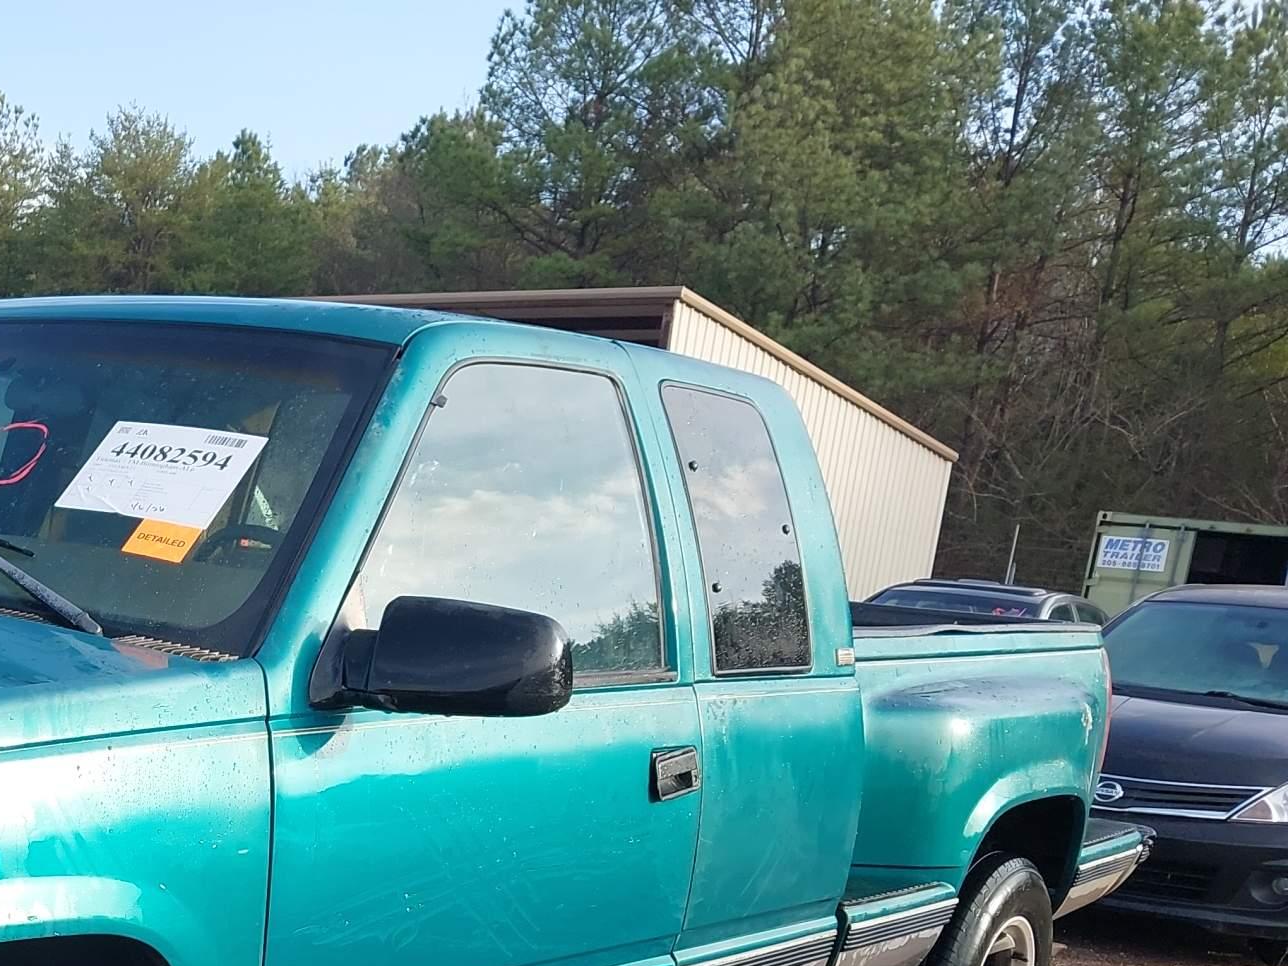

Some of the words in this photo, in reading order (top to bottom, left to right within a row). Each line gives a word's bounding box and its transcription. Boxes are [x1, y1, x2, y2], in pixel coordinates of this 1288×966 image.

[111, 441, 233, 471] 44082594
[136, 531, 186, 549] DETAILED
[1104, 538, 1166, 553] METRO
[1103, 550, 1162, 562] TRAILER
